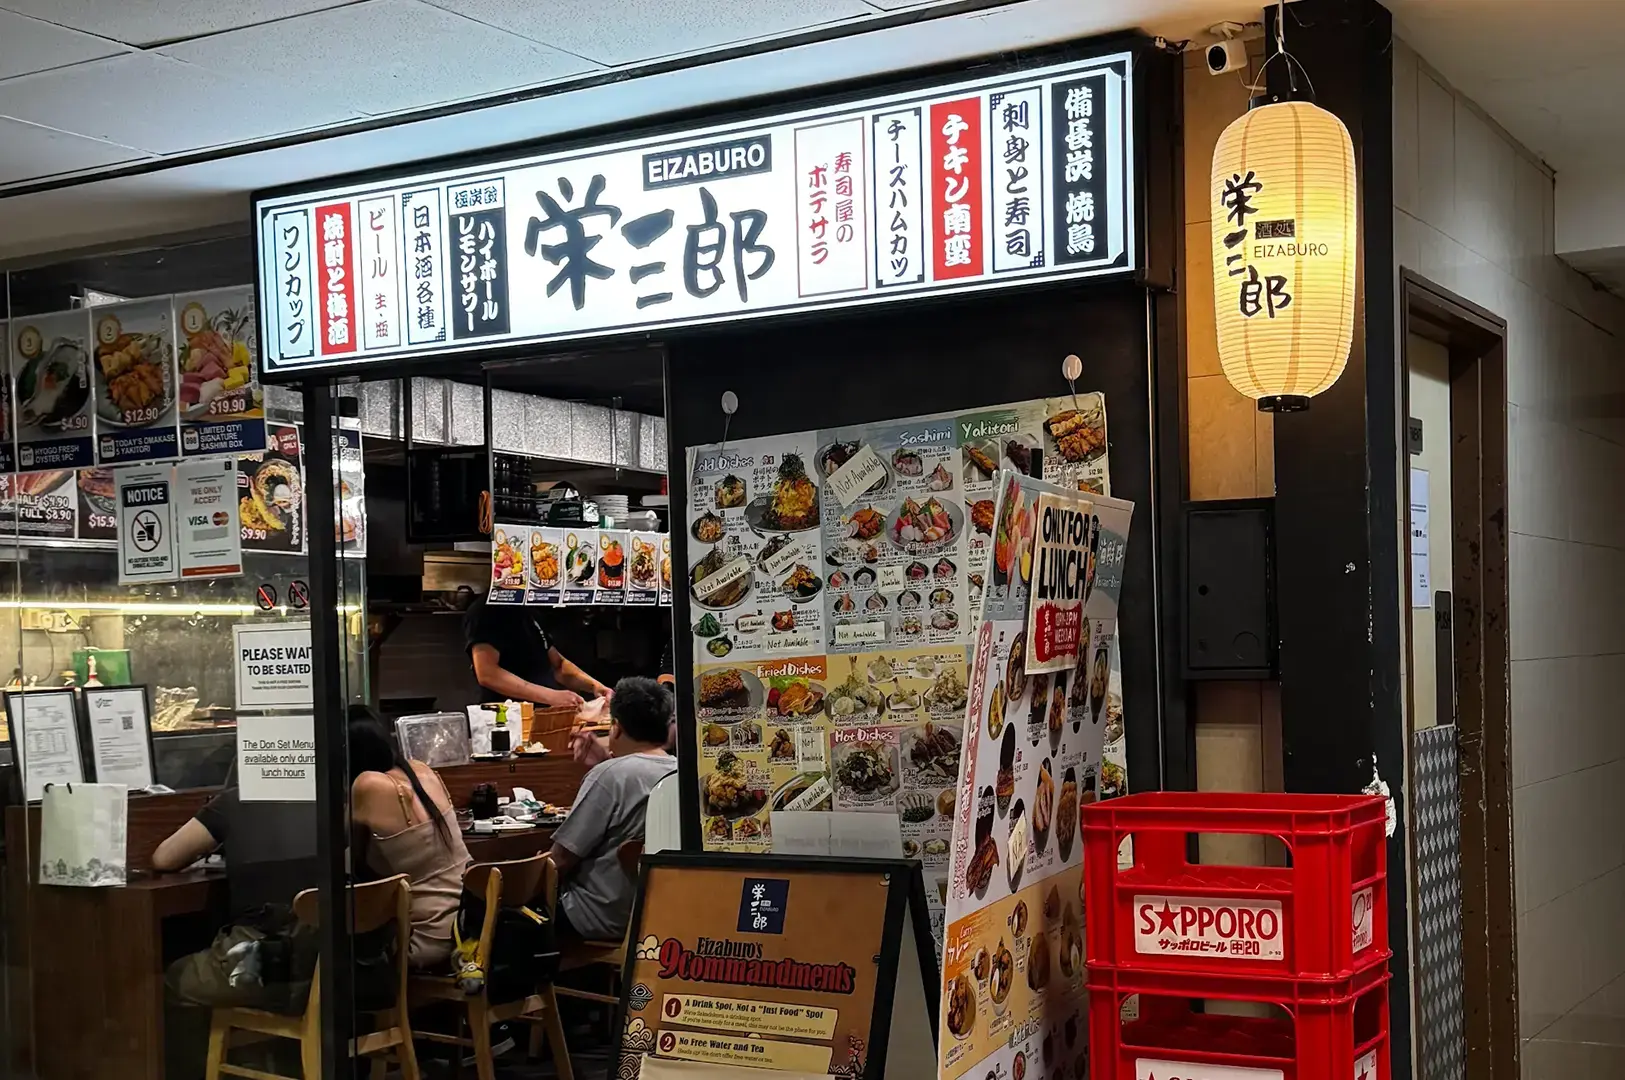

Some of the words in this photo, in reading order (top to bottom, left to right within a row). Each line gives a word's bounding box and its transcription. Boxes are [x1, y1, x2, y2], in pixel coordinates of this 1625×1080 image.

[1065, 86, 1094, 183] 備長炭
[648, 143, 765, 183] EIZABURO
[1002, 100, 1031, 258] 刺身と寿司
[834, 151, 855, 243] 寿司屋の
[887, 119, 908, 278] チーズハムカツ
[942, 114, 972, 267] チキン南蛮
[808, 163, 829, 265] ポテサラ
[1065, 191, 1095, 255] 焼鳥
[369, 207, 388, 279] ビール
[524, 173, 775, 311] 栄三郎
[1221, 170, 1293, 319] 栄三郎
[1253, 243, 1329, 258] EIZABURO
[413, 205, 436, 329] 日本酒各種
[458, 216, 478, 332] レモンサワー
[479, 221, 499, 321] ハイボール
[283, 225, 306, 345] ワンカップ
[322, 213, 349, 345] 焼酎と梅酒
[209, 399, 246, 415] $19.90
[61, 416, 88, 431] $4.90
[125, 408, 159, 424] $12.90
[200, 426, 226, 435] LIMITED
[962, 417, 1020, 438] Yakitori
[115, 436, 143, 447] TODAY'S
[143, 434, 175, 444] OMAKASE
[200, 432, 238, 442] SIGNATURE
[200, 441, 228, 450] SASHIMI
[228, 439, 244, 448] BOX
[280, 434, 296, 442] LUNCH
[900, 427, 952, 446] Sashimi
[58, 444, 80, 454] FRESH
[121, 445, 151, 456] YAKITORI
[283, 442, 297, 450] ONLY
[35, 454, 61, 464] OYSTER
[694, 458, 715, 472] old
[717, 454, 754, 470] Dishes
[834, 476, 854, 497] Not
[851, 456, 881, 485] Available
[127, 487, 164, 503] NOTICE
[191, 487, 203, 496] WE
[203, 485, 223, 494] ONLY
[42, 495, 69, 508] $4.90
[193, 495, 222, 505] ACCEPT
[20, 507, 43, 519] FULL
[45, 508, 72, 520] $8.90
[188, 515, 209, 526] VISA
[241, 528, 267, 540] $9.90
[1042, 506, 1067, 545] ONLY
[1067, 511, 1090, 548] FOR
[770, 558, 782, 569] Not
[699, 583, 715, 594] Not
[716, 565, 743, 586] Available
[883, 569, 895, 577] Not
[1037, 547, 1087, 600] LUNCH
[767, 639, 782, 649] Not
[783, 637, 809, 648] Available
[838, 631, 849, 639] Not
[243, 648, 283, 661] PLEASE
[247, 665, 261, 676] TO
[262, 665, 275, 675] BE
[275, 663, 311, 675] SEATED
[757, 664, 787, 678] Fried
[787, 662, 822, 677] Dishes
[802, 736, 815, 749] Not
[835, 730, 857, 743] Hot
[857, 728, 893, 742] Dishes
[243, 740, 258, 749] The
[259, 740, 276, 749] Don
[278, 740, 291, 749] Set
[292, 740, 314, 749] Menu
[244, 754, 279, 764] available
[280, 754, 297, 766] only
[261, 767, 282, 777] lunch
[284, 767, 305, 777] hours
[803, 785, 827, 808] Available
[697, 937, 763, 959] Eizaburo's
[1158, 938, 1228, 953] サッポロビール
[659, 937, 684, 979] 9
[692, 999, 713, 1009] Drink
[736, 1002, 750, 1011] Not
[806, 1009, 824, 1019] Spot
[664, 1036, 673, 1051] 2
[679, 1037, 689, 1045] No
[691, 1038, 708, 1047] Free
[709, 1040, 732, 1050] Water
[733, 1043, 748, 1051] and
[751, 1044, 765, 1054] Tea
